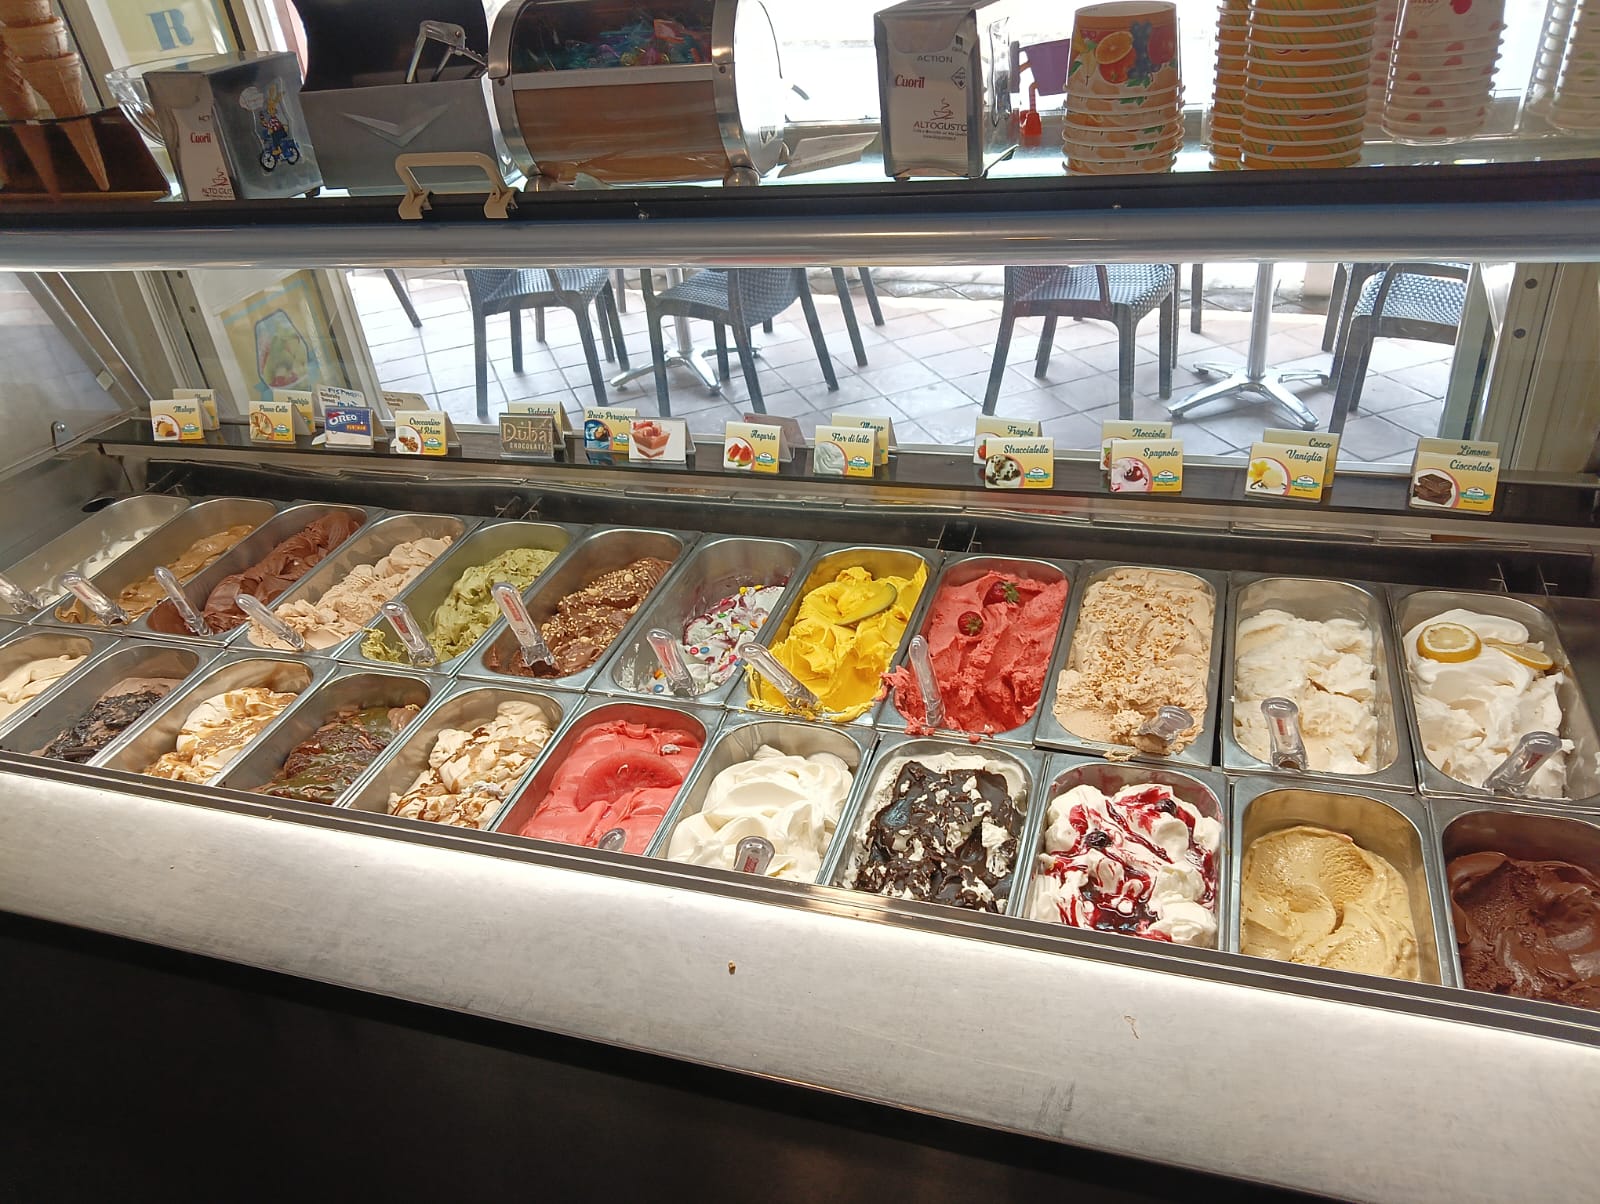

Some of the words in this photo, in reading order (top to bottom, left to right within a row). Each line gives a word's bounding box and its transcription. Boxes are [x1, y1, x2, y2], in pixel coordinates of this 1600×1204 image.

[146, 8, 195, 50] R
[917, 54, 953, 64] ACTION
[329, 413, 357, 426] OREO
[1007, 424, 1034, 437] Fragola
[1132, 427, 1166, 438] Nocciola
[831, 432, 847, 443] Fior
[848, 433, 855, 443] di
[856, 433, 870, 444] latte
[1308, 437, 1332, 449] Cocco
[1003, 444, 1049, 454] Stracciatella
[1143, 447, 1179, 460] Spagnola
[1456, 444, 1490, 457] Limone
[1286, 449, 1323, 463] Vaniglia
[1449, 459, 1493, 473] Cioccolato
